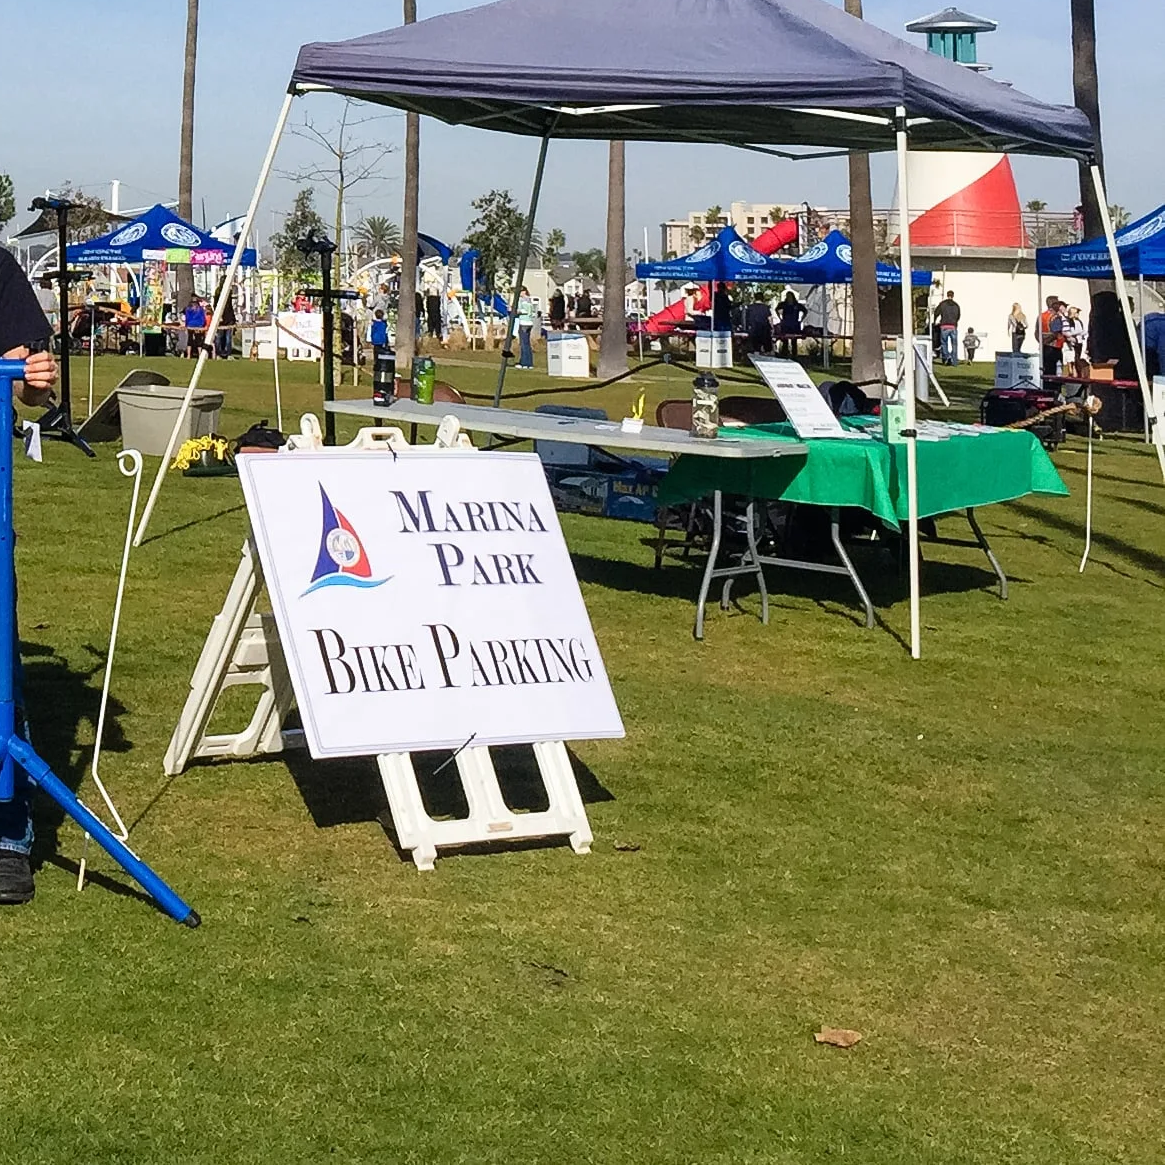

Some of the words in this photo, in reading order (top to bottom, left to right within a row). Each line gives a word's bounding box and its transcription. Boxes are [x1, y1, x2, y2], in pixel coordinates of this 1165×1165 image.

[388, 490, 549, 534] MARINA
[428, 542, 543, 587] PARK
[308, 628, 426, 696] BIKE
[422, 623, 596, 690] PARKING
